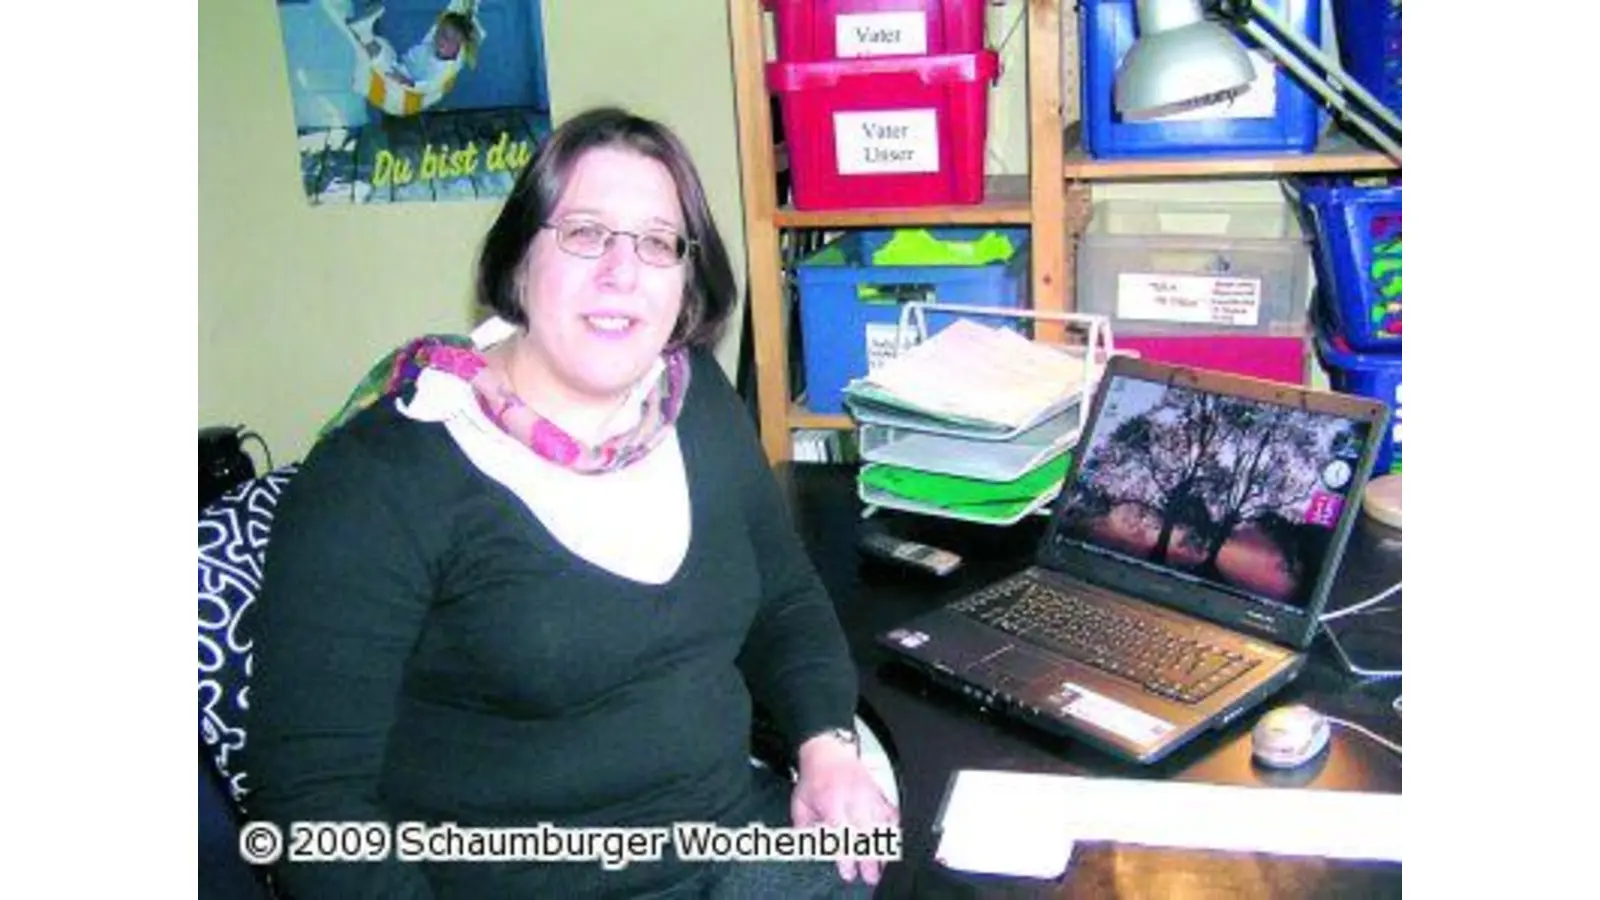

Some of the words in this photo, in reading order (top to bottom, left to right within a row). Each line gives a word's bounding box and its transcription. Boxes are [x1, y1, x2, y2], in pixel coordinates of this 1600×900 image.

[855, 27, 901, 43] Vater
[862, 122, 909, 139] Vater
[373, 150, 412, 186] Du
[420, 142, 478, 179] bist
[486, 132, 531, 172] du
